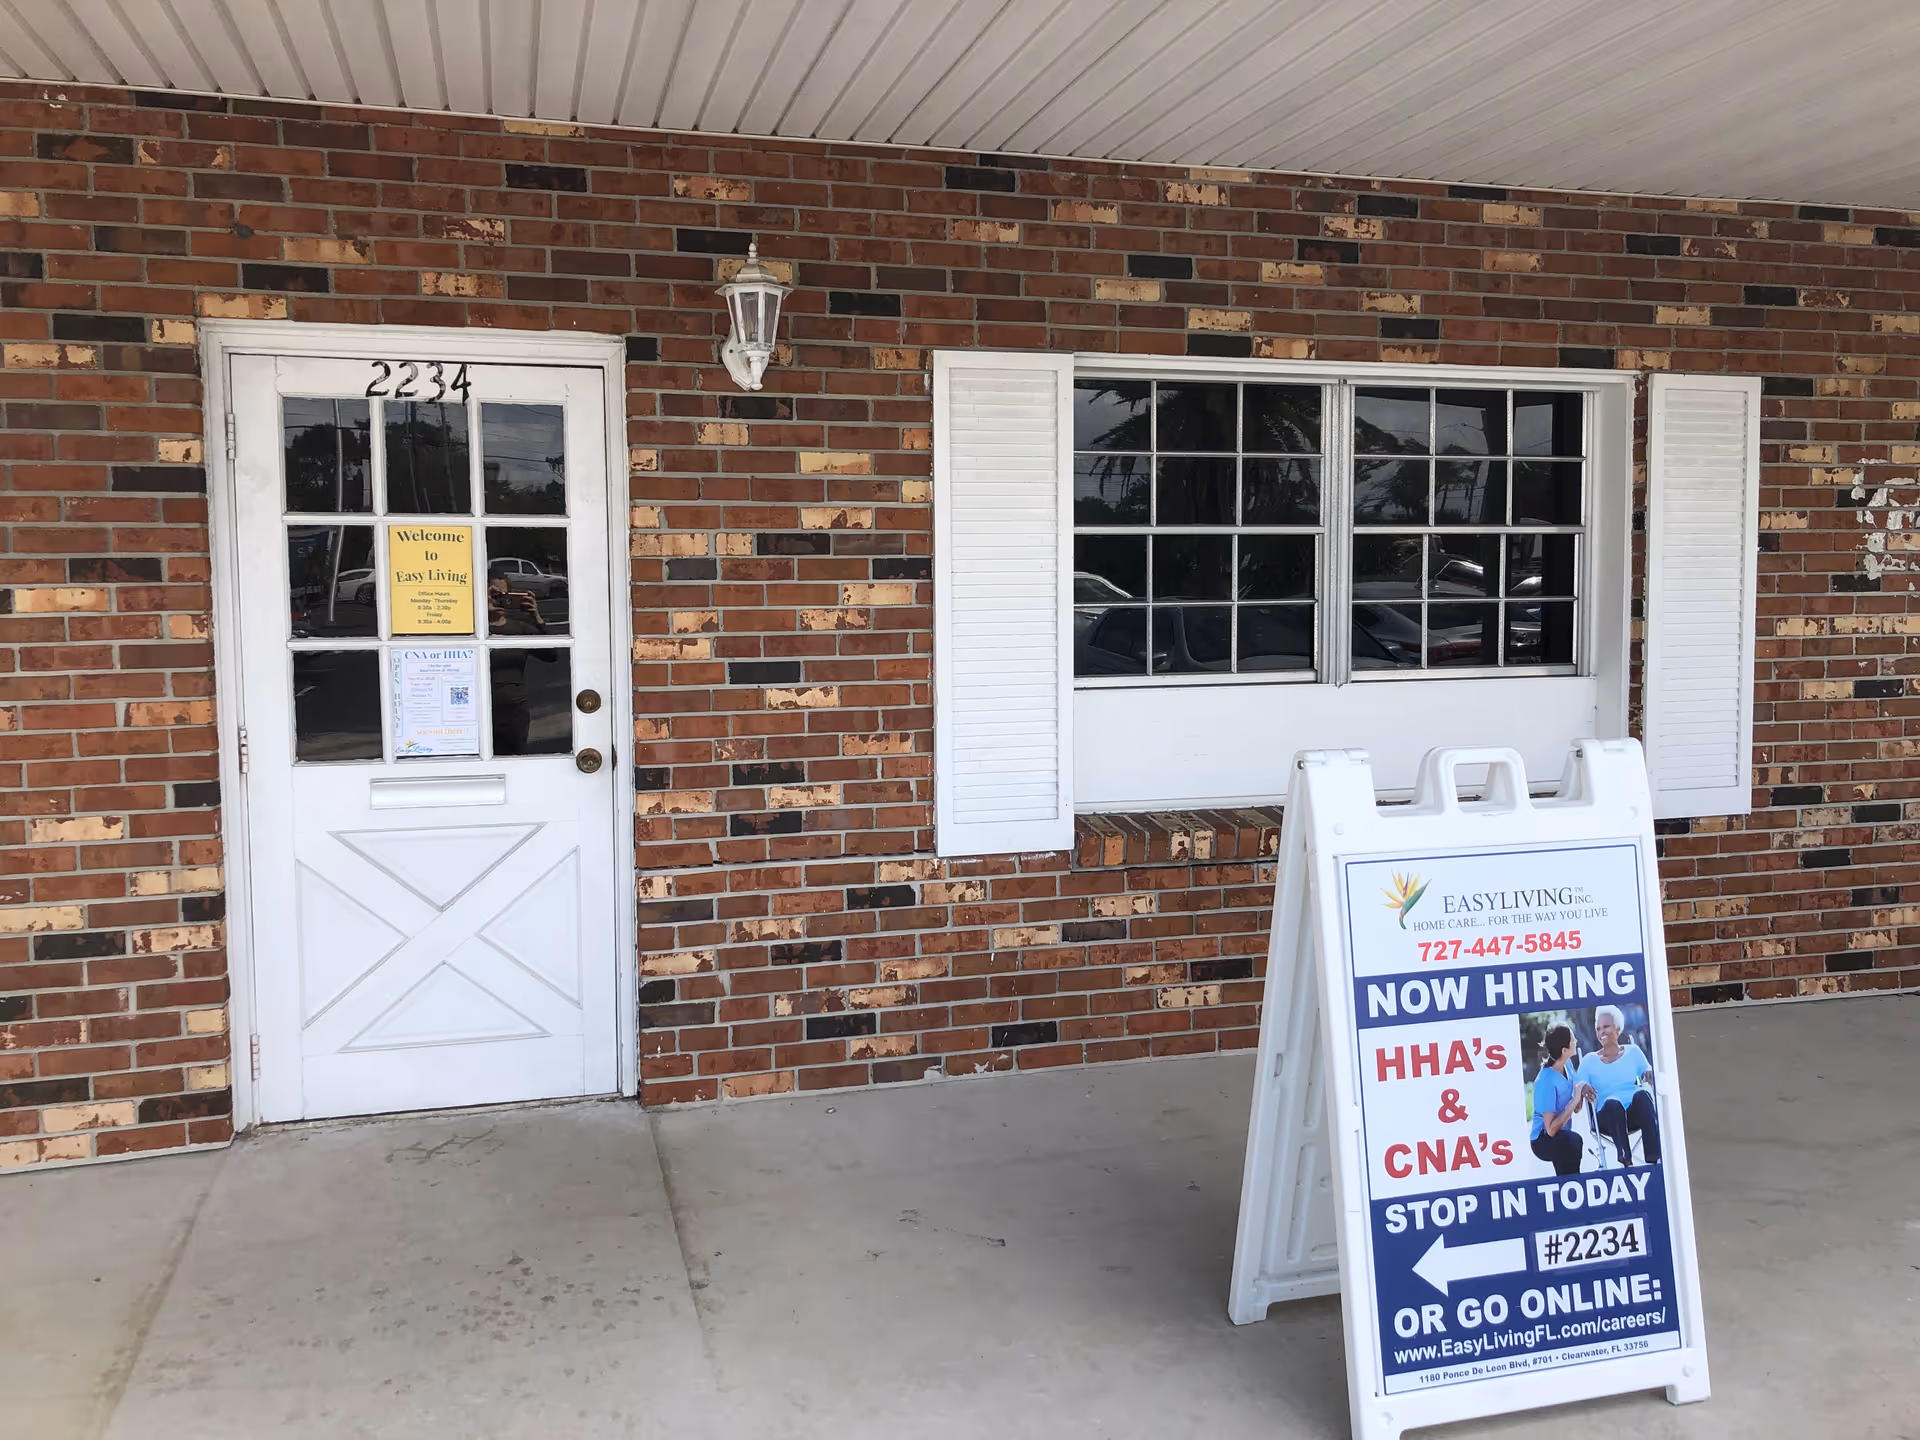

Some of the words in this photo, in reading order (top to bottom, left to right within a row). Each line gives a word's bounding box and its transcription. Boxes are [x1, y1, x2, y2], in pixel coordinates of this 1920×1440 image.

[366, 361, 472, 406] 2234
[396, 529, 464, 543] Welcome
[425, 550, 438, 561] to
[395, 570, 424, 583] Easy
[428, 568, 468, 585] Living
[405, 651, 427, 659] CNA
[444, 650, 473, 659] HHA?
[1413, 919, 1445, 931] HOME
[1448, 917, 1485, 929] CARE...
[1488, 915, 1509, 926] FOR
[1512, 914, 1533, 924] THE
[1535, 912, 1558, 923] WAY
[1559, 910, 1582, 920] YOU
[1584, 908, 1608, 919] LIVE
[1574, 895, 1593, 905] INC.
[1418, 930, 1582, 962] 727-447-5845
[1367, 975, 1469, 1018] NOW
[1484, 962, 1636, 1007] HIRING
[1375, 1037, 1507, 1082] HHA's
[1438, 1088, 1469, 1123] &
[1384, 1132, 1514, 1179] CNA's
[1385, 1194, 1478, 1234] STOP
[1490, 1187, 1527, 1220] IN
[1537, 1172, 1651, 1212] TODAY
[1544, 1223, 1640, 1266] #2234
[1393, 1303, 1447, 1338] OR
[1456, 1294, 1509, 1328] GO
[1519, 1273, 1662, 1319] ONLINE:
[1394, 1307, 1666, 1365] www.EasyLivingFL.com/careers/
[1419, 1373, 1441, 1384] 1180
[1443, 1369, 1470, 1380] Ponce
[1472, 1367, 1484, 1376] De
[1486, 1364, 1507, 1373] Leon
[1509, 1359, 1531, 1370] Blvd,
[1532, 1356, 1553, 1366] #701
[1561, 1348, 1610, 1361] Clearwater,
[1612, 1345, 1622, 1354] FL
[1624, 1341, 1649, 1351] 33756
